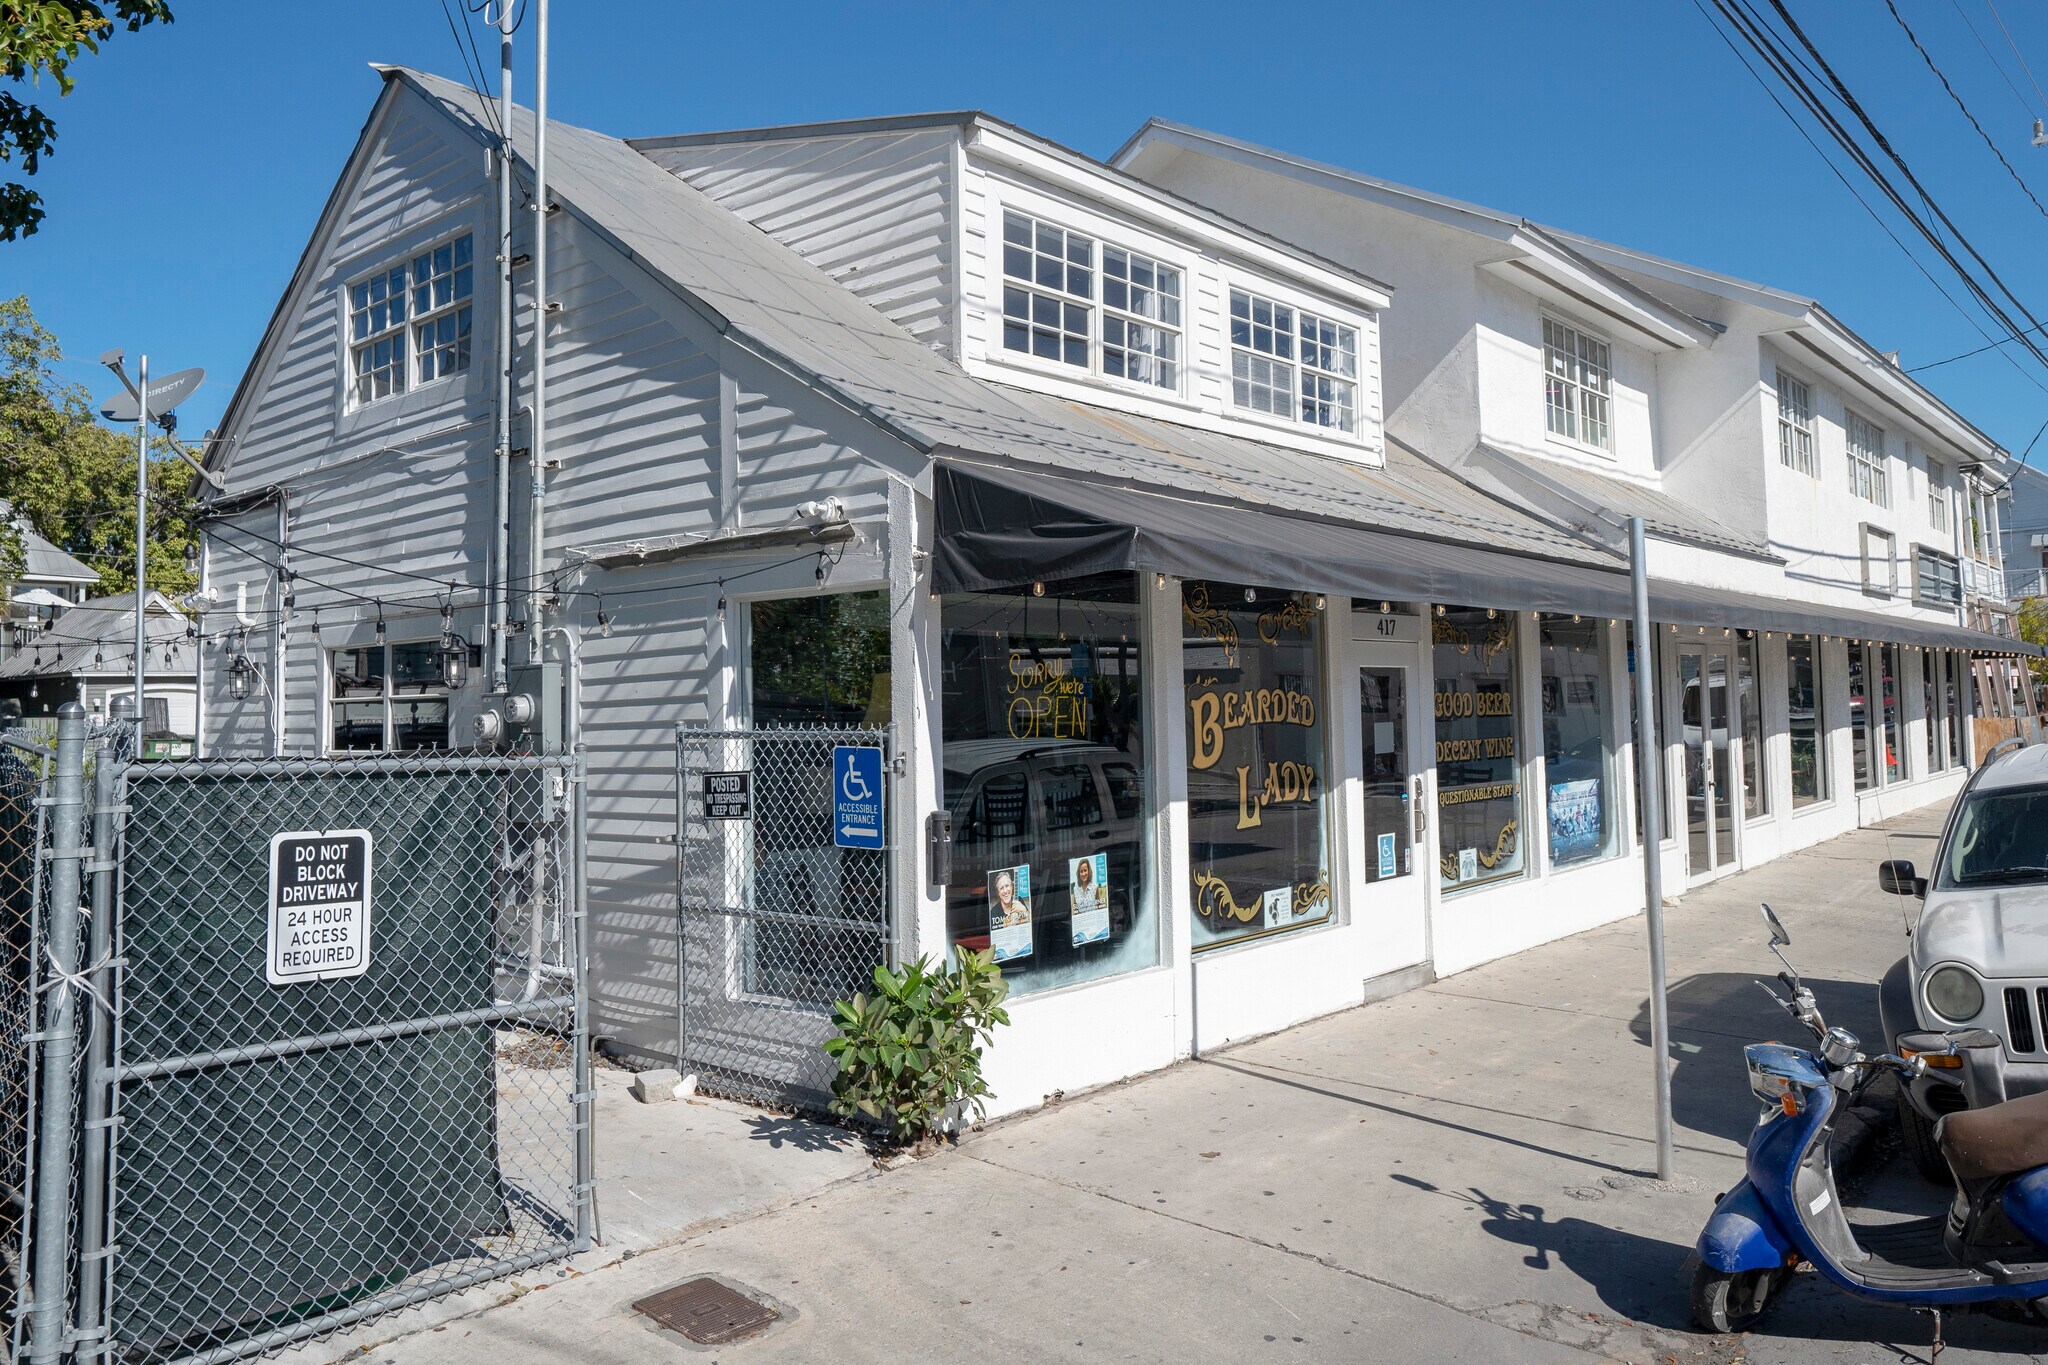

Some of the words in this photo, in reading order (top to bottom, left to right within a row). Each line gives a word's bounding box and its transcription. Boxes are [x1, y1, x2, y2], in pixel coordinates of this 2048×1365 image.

[1376, 618, 1396, 636] 417
[1434, 692, 1473, 717] GOOD
[1476, 691, 1512, 716] BEER
[1008, 696, 1087, 740] OPEN
[1190, 688, 1315, 770] BEARDED
[1436, 739, 1483, 763] DECENT
[1484, 736, 1514, 758] WINE
[710, 776, 741, 793] POSTED
[706, 793, 714, 804] NO
[714, 792, 747, 804] TRESPASSING
[1236, 760, 1315, 830] LADY
[1439, 786, 1493, 808] QUESTIONABLE
[1493, 783, 1513, 798] STAFF
[711, 805, 728, 816] KEEP
[729, 804, 742, 816] OUT
[838, 802, 878, 814] ACCESSIBLE
[841, 813, 876, 825] ENTRANCE
[295, 846, 315, 862] DO
[320, 844, 349, 861] NOT
[297, 863, 346, 882] BLOCK
[282, 881, 359, 903] DRIVEWAY
[287, 911, 307, 927] 24
[312, 907, 352, 925] HOUR
[290, 927, 348, 947] ACCESS
[282, 946, 355, 968] REQUIRED
